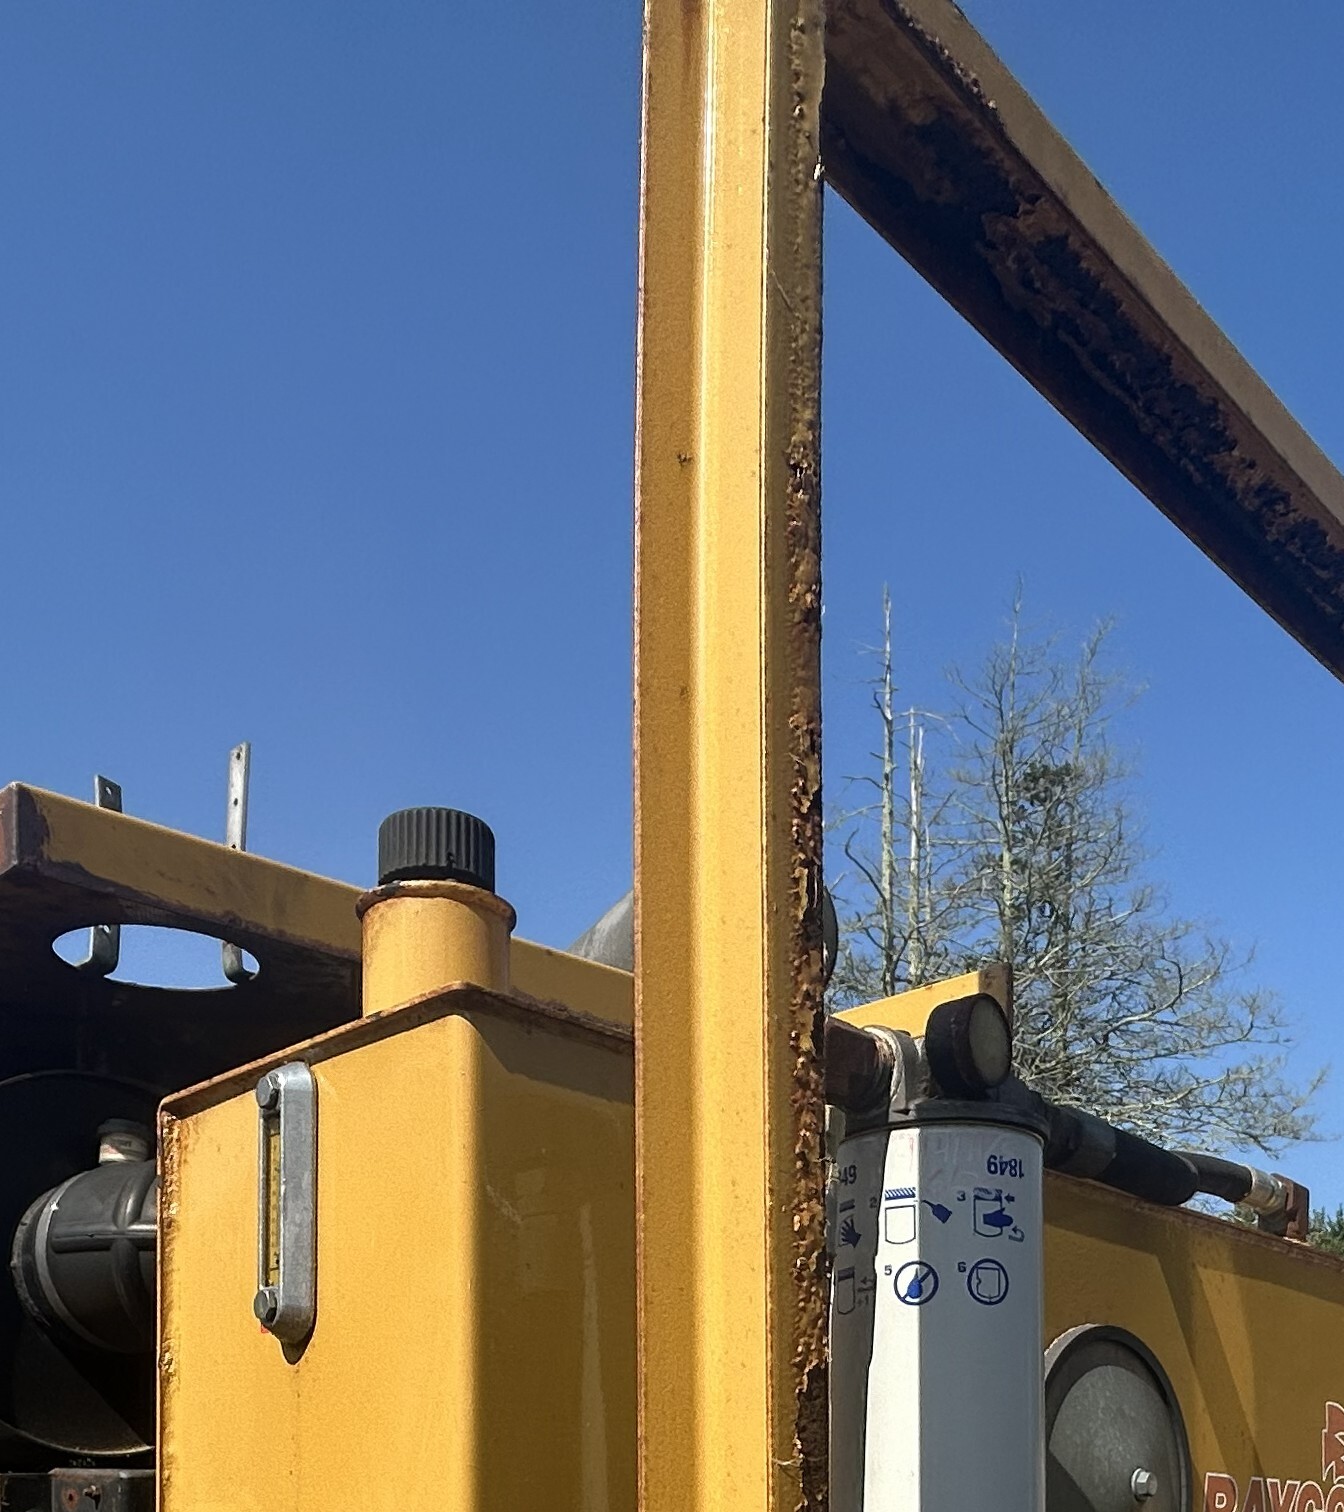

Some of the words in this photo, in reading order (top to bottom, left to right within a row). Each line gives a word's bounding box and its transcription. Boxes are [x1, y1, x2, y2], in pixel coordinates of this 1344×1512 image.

[987, 1154, 1024, 1178] 1849
[957, 1191, 966, 1201] 3
[869, 1197, 878, 1208] 2
[884, 1265, 892, 1275] 5
[958, 1262, 966, 1273] 6
